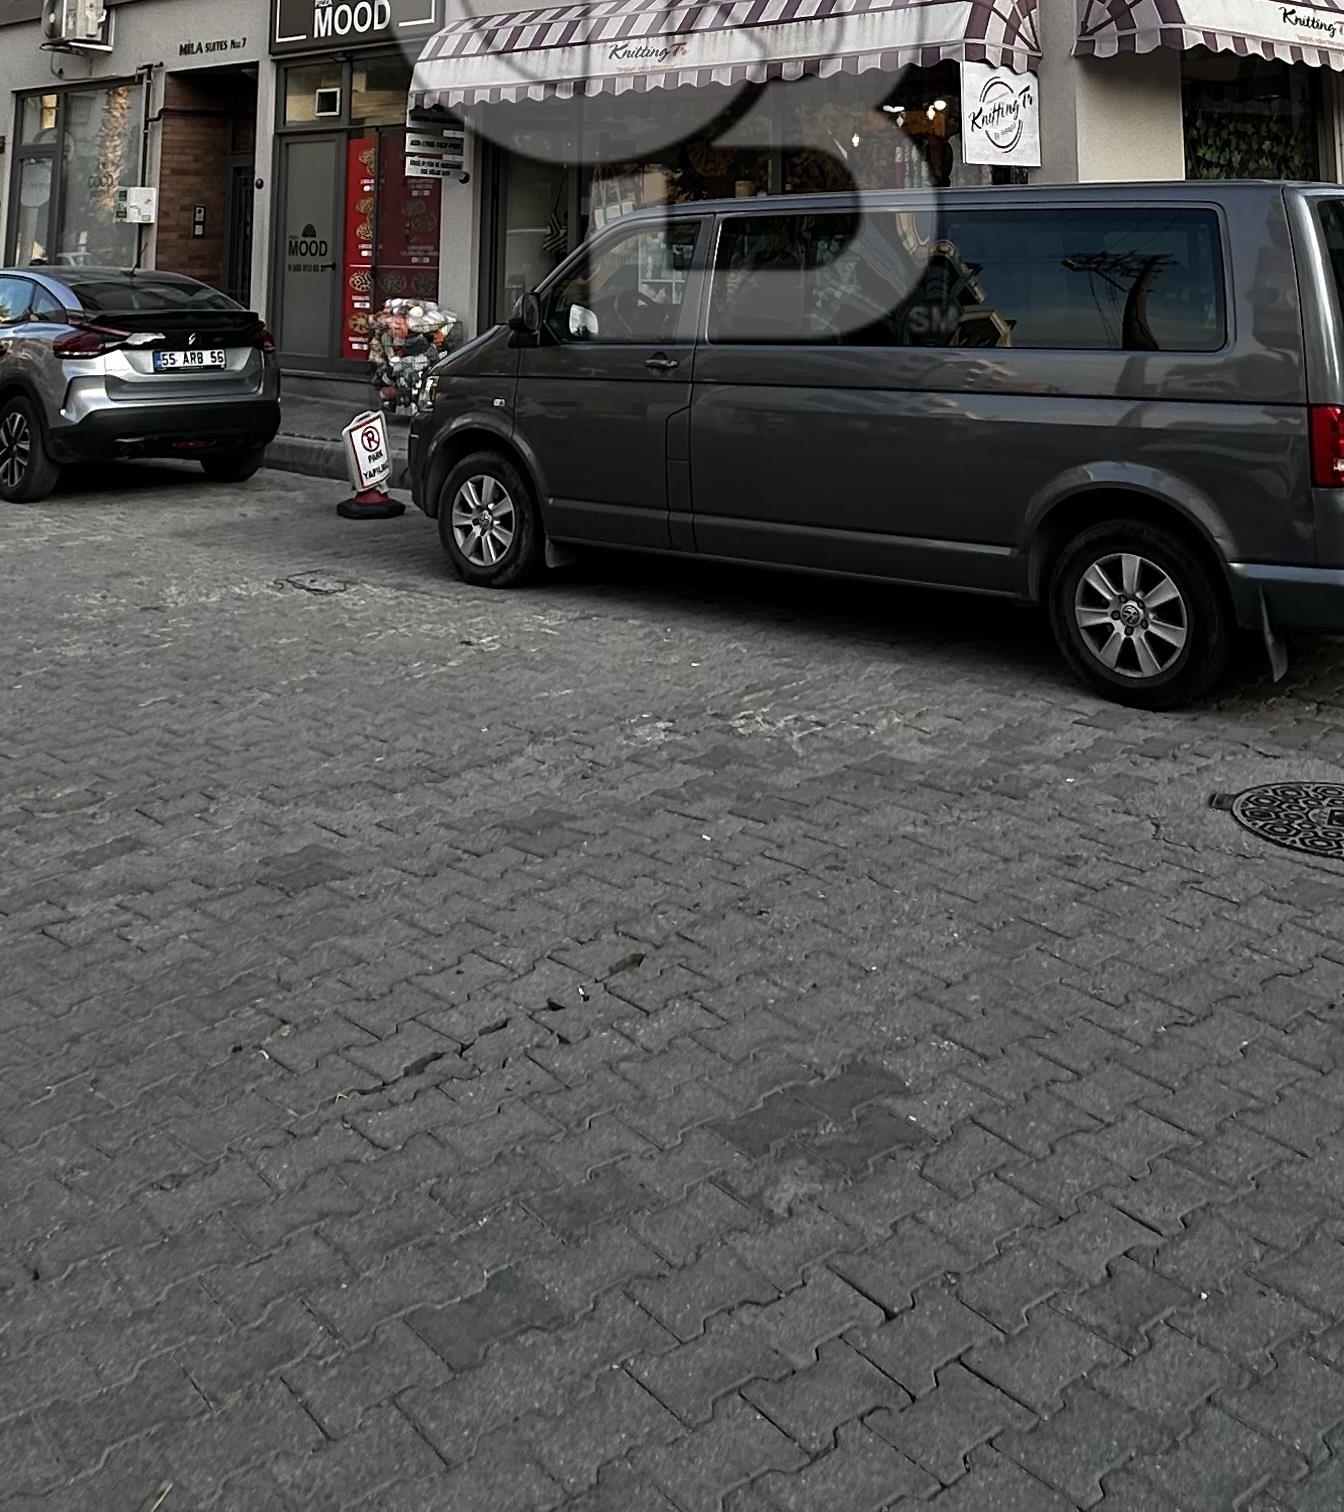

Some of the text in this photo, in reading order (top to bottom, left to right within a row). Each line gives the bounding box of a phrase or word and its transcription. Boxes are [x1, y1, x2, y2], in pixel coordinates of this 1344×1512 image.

[313, 0, 391, 38] MOOD
[288, 240, 328, 257] MOOD
[183, 351, 204, 365] ARB
[210, 351, 224, 364] 56
[368, 449, 383, 463] PARK
